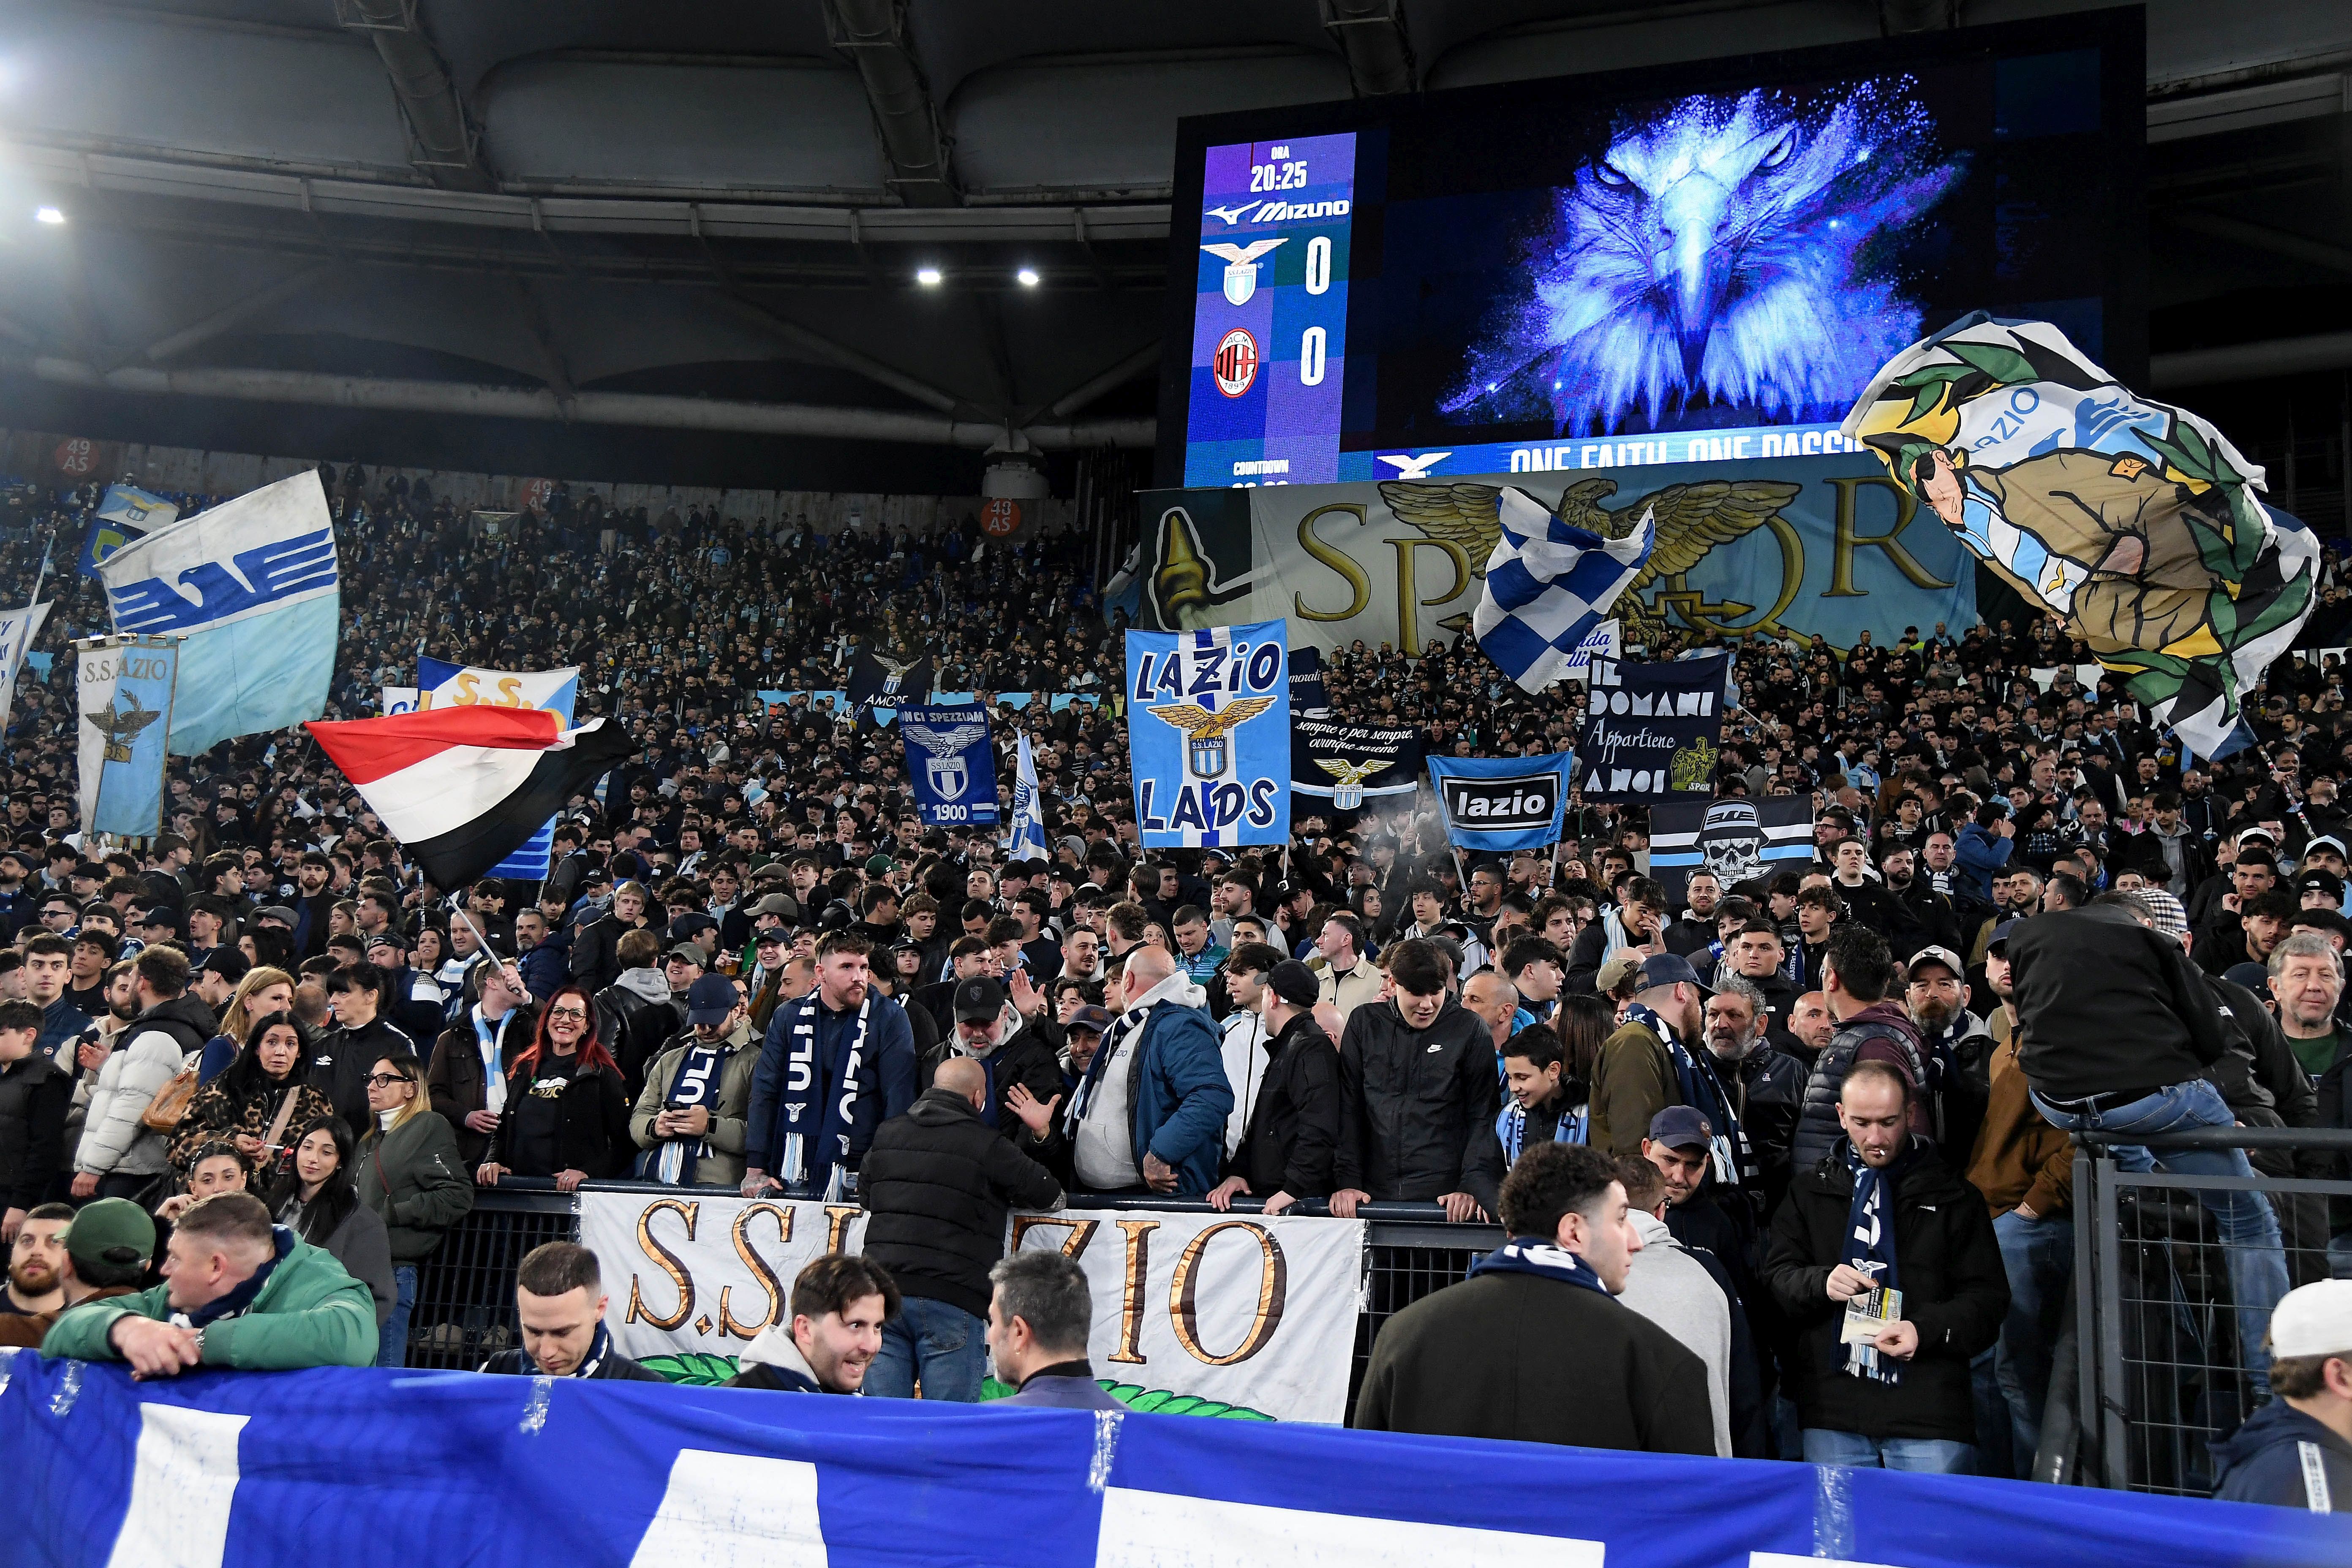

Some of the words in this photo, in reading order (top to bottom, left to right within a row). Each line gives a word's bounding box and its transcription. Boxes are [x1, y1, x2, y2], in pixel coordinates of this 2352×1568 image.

[1271, 146, 1289, 161] ORA
[1250, 161, 1307, 193] 20:25
[1306, 236, 1331, 295] 0
[1226, 334, 1249, 345] ACM
[1301, 326, 1326, 386] 0
[1225, 381, 1245, 389] 1899
[1968, 387, 2040, 454] AZIO
[67, 440, 91, 455] 49
[63, 456, 88, 472] AS
[1233, 459, 1290, 476] COUNTDOWN
[988, 516, 1010, 531] AS
[117, 656, 167, 681] AZIO
[1134, 641, 1283, 702] LAZIO
[1288, 669, 1322, 683] morati
[1592, 660, 1622, 686] IL
[1589, 690, 1714, 716] DOMANI
[1295, 721, 1338, 736] sempre
[1339, 727, 1348, 735] e
[1339, 728, 1369, 741] per
[1309, 738, 1356, 753] ovunque
[1355, 744, 1399, 754] saremo
[1587, 718, 1676, 764] Appartiene
[104, 745, 123, 760] QR
[1584, 768, 1603, 792] A
[1609, 768, 1666, 793] NOI
[1689, 782, 1710, 792] SPQR
[1141, 778, 1279, 833] LADS
[1457, 789, 1546, 817] lazio
[932, 804, 968, 821] 1900
